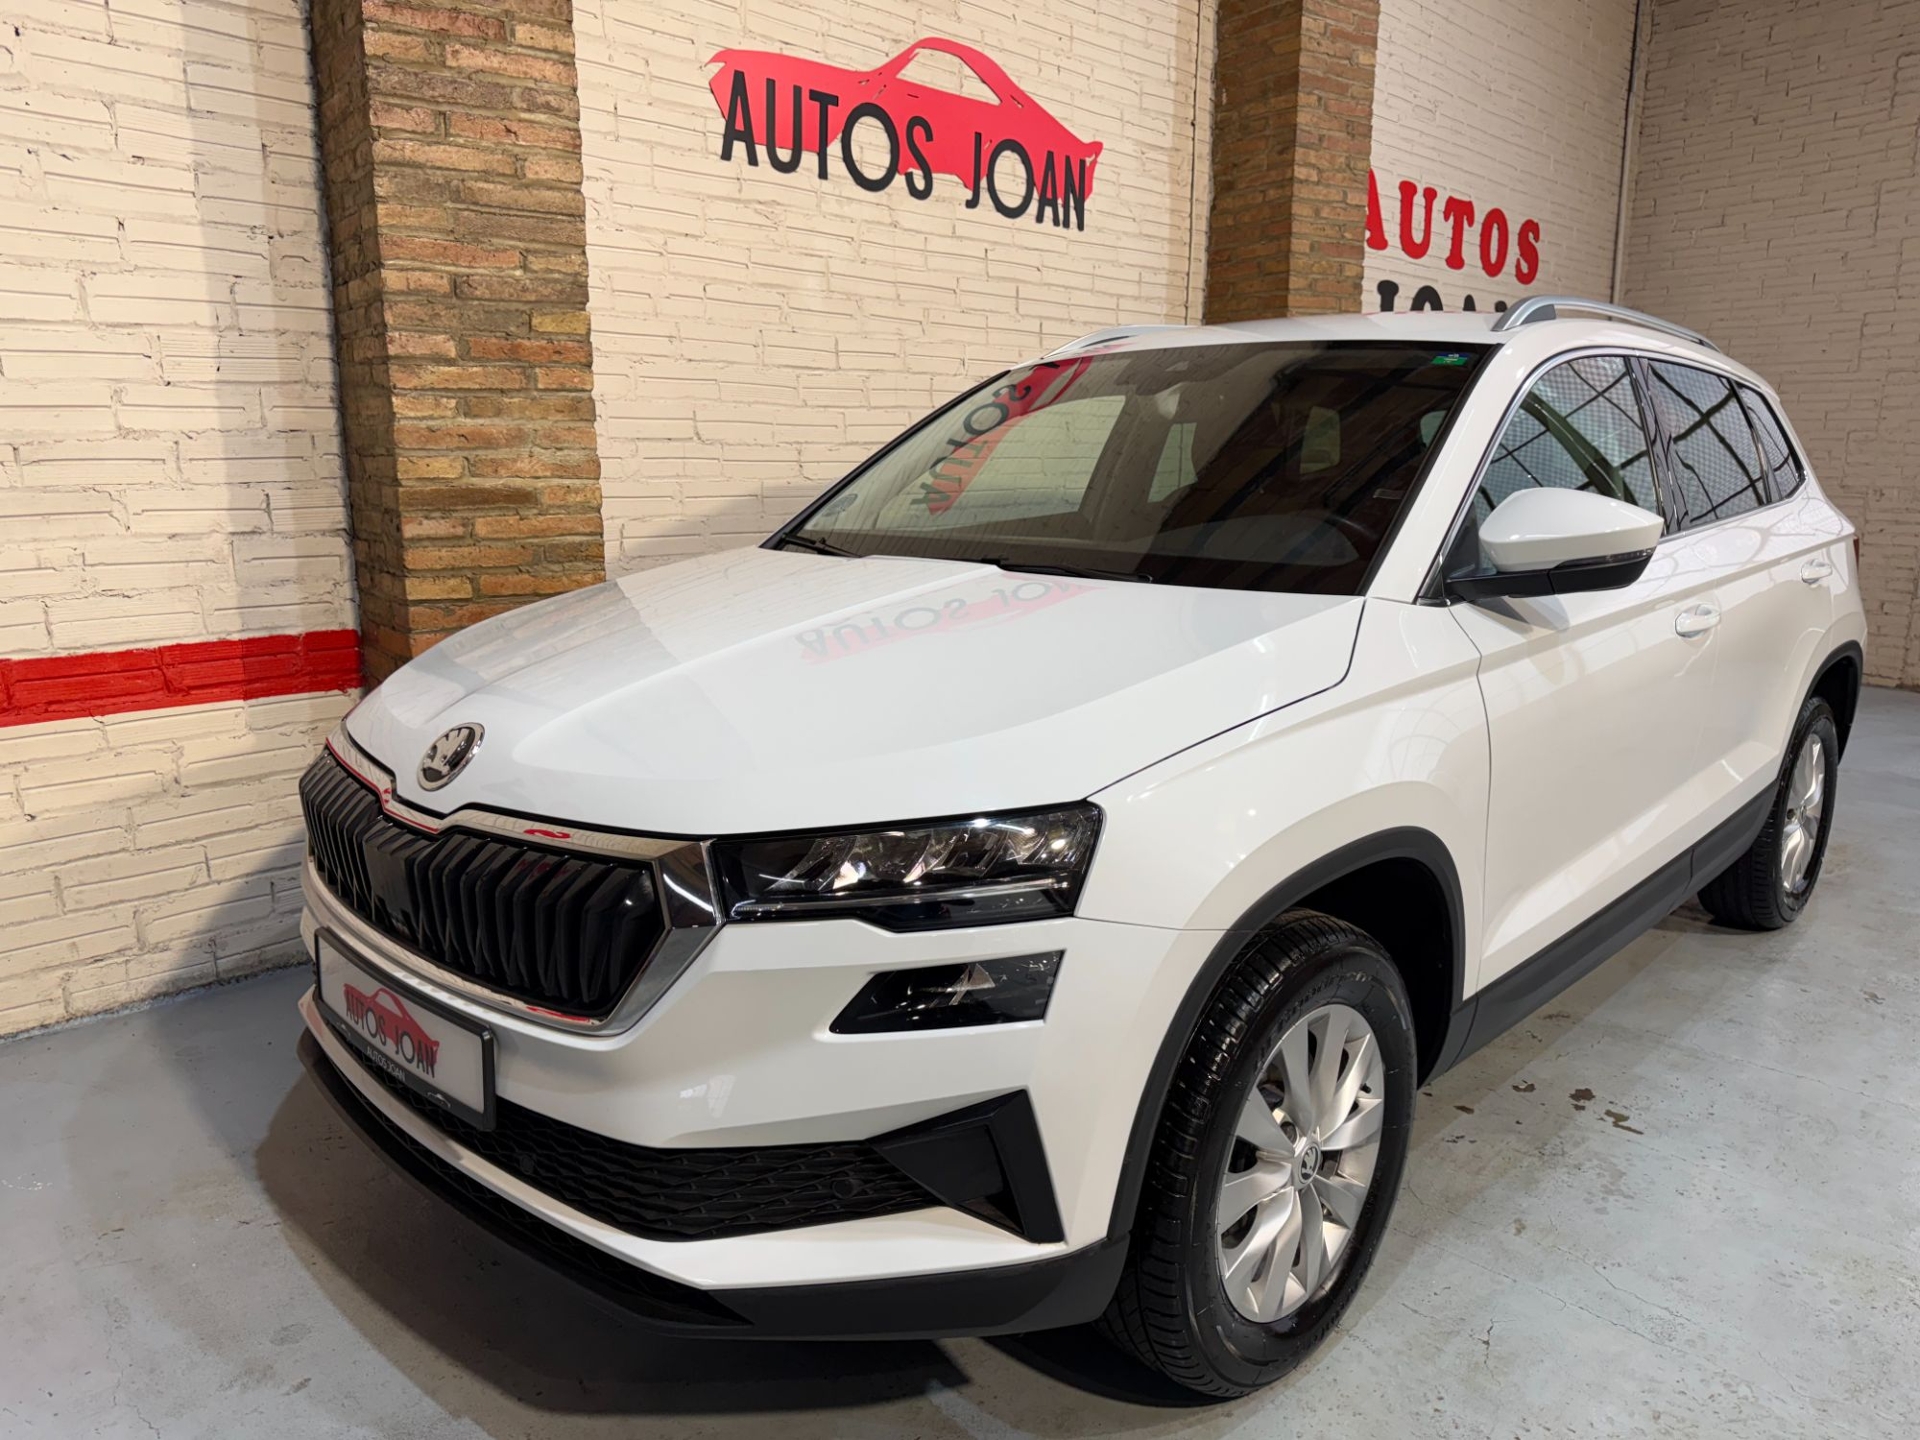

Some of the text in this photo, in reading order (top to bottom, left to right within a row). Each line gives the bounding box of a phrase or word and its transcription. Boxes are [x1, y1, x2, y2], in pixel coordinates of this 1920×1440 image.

[720, 69, 1086, 232] AUTOS JOAN
[345, 991, 436, 1079] AUTOS JOAN
